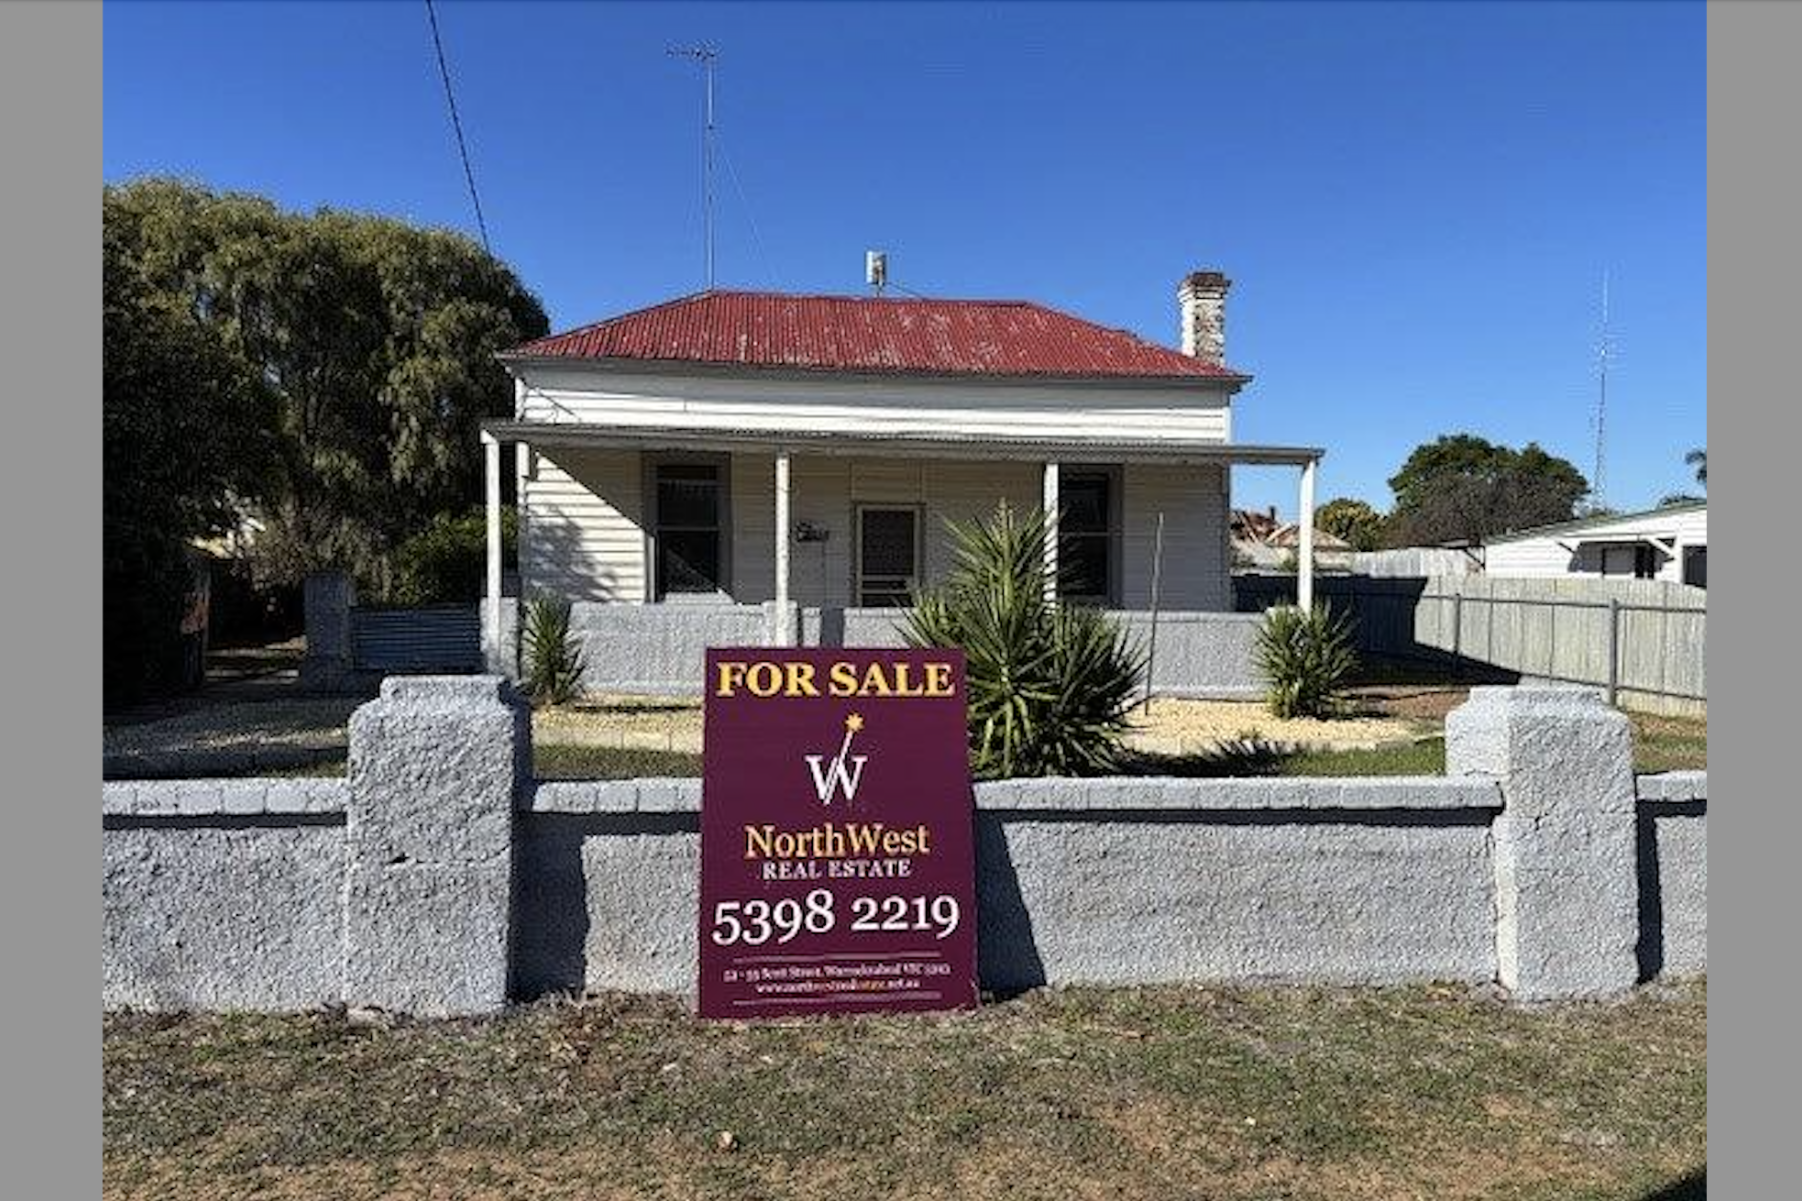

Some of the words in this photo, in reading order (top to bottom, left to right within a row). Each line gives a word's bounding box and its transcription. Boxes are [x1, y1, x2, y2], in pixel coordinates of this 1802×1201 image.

[715, 662, 820, 697] FOR
[828, 662, 956, 697] SALE
[744, 822, 930, 860] NorthWest
[762, 860, 822, 880] REAL
[828, 857, 912, 879] ESTATE
[712, 888, 835, 946] 5398
[851, 895, 960, 940] 2219
